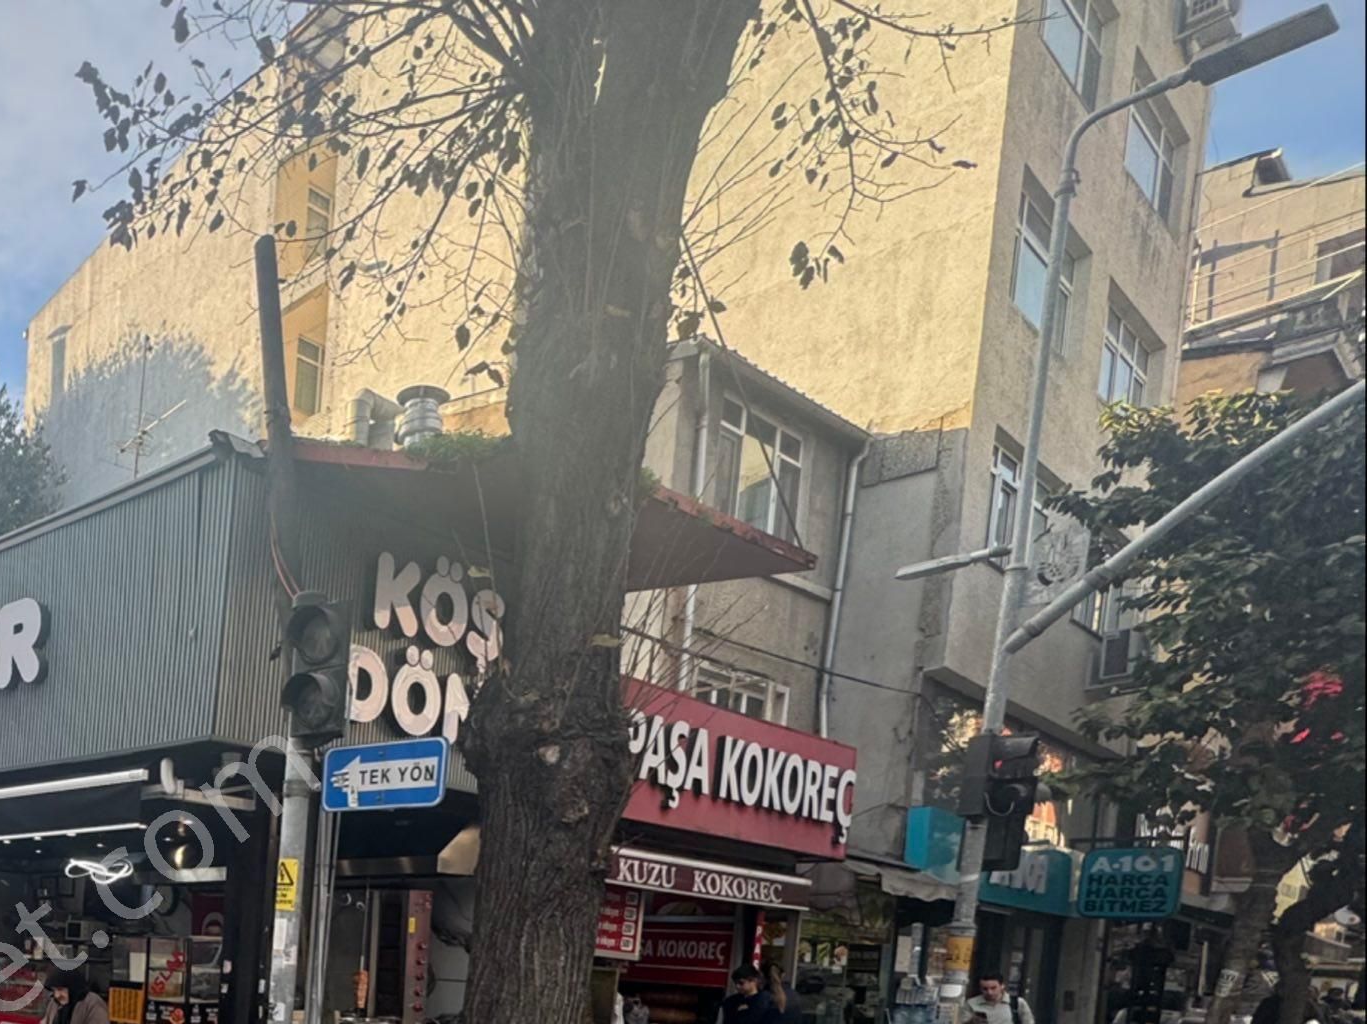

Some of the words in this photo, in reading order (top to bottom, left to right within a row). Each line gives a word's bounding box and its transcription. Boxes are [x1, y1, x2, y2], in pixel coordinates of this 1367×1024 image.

[359, 767, 391, 785] TEK
[398, 761, 436, 782] YÖN
[719, 735, 857, 845] KOKOREÇ
[617, 858, 676, 889] KUZU
[1087, 874, 1169, 888] HARCA
[1086, 887, 1168, 900] HARCA
[657, 939, 727, 965] KOKOREÇ
